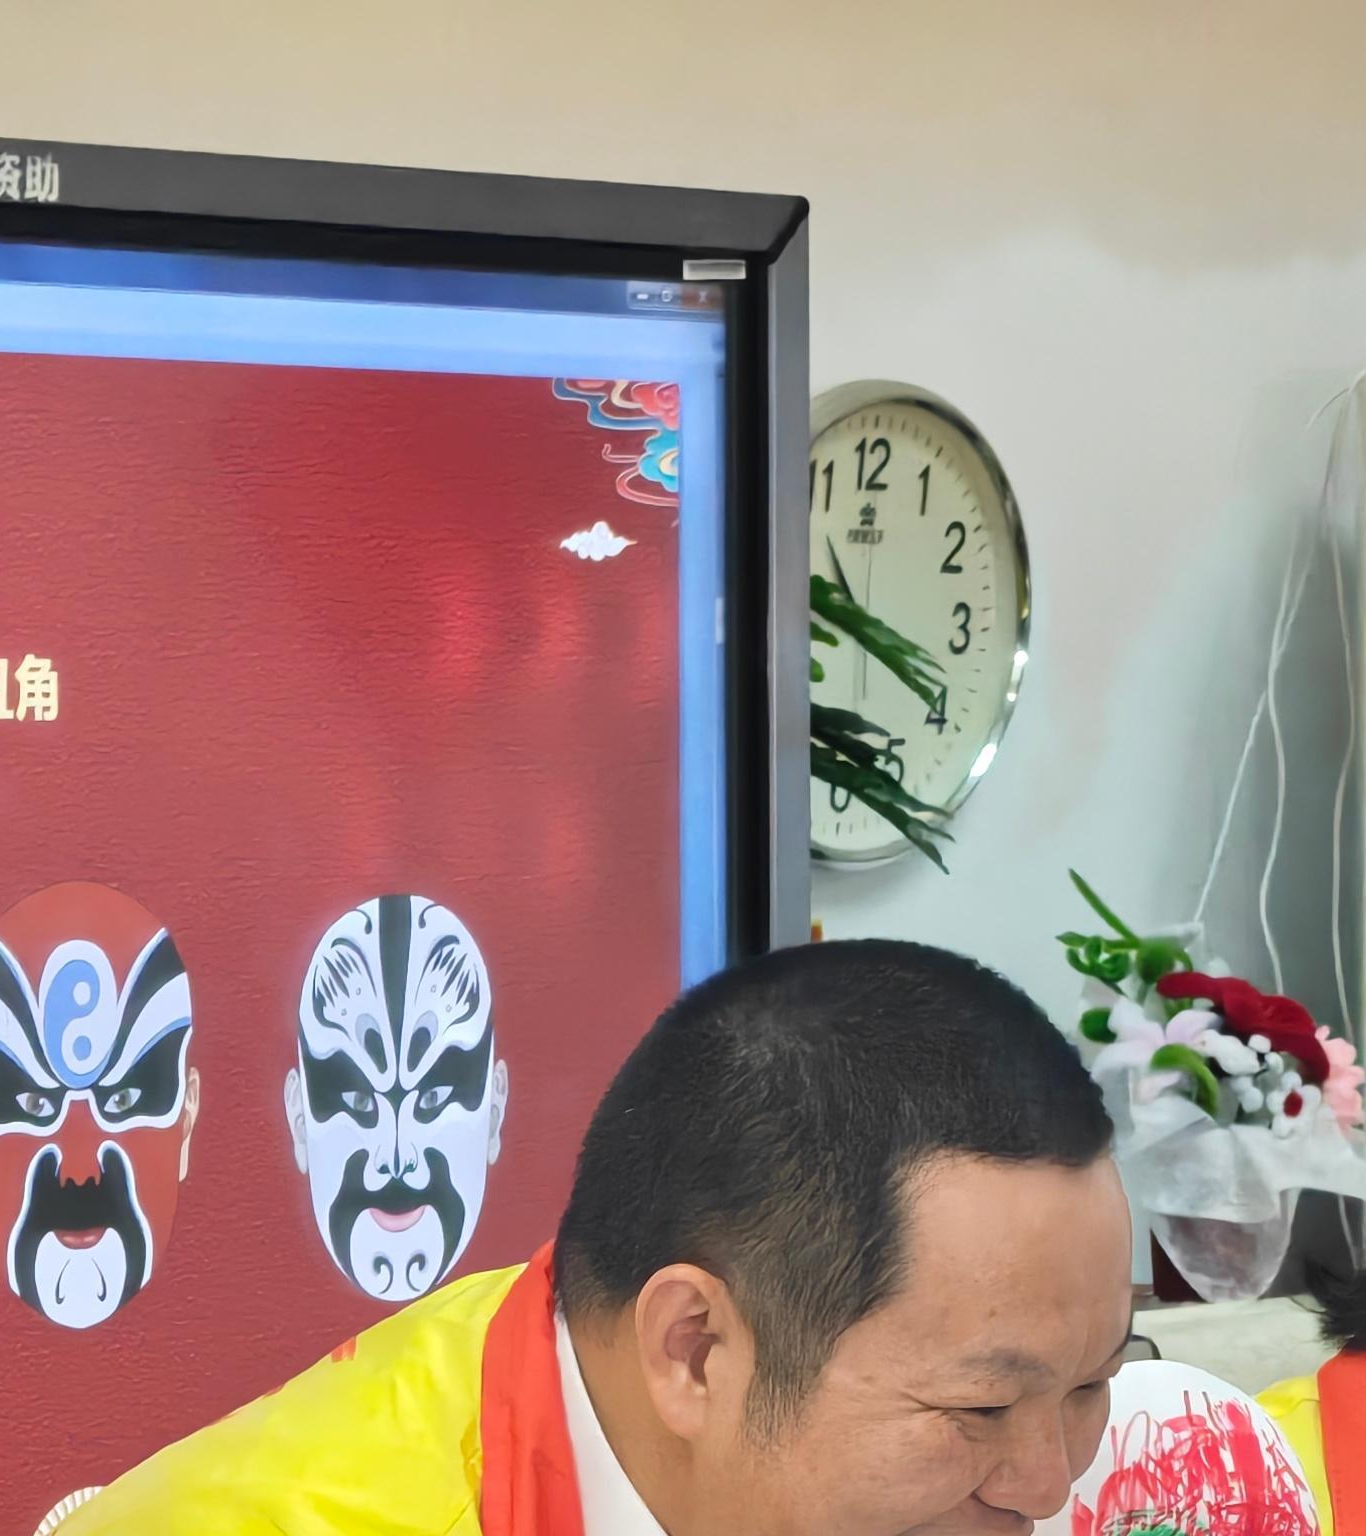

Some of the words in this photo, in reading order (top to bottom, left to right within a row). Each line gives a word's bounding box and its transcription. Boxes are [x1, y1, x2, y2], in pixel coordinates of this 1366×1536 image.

[854, 437, 891, 493] 12
[917, 464, 931, 516] 1
[939, 520, 967, 574] 2
[948, 601, 972, 656] 3
